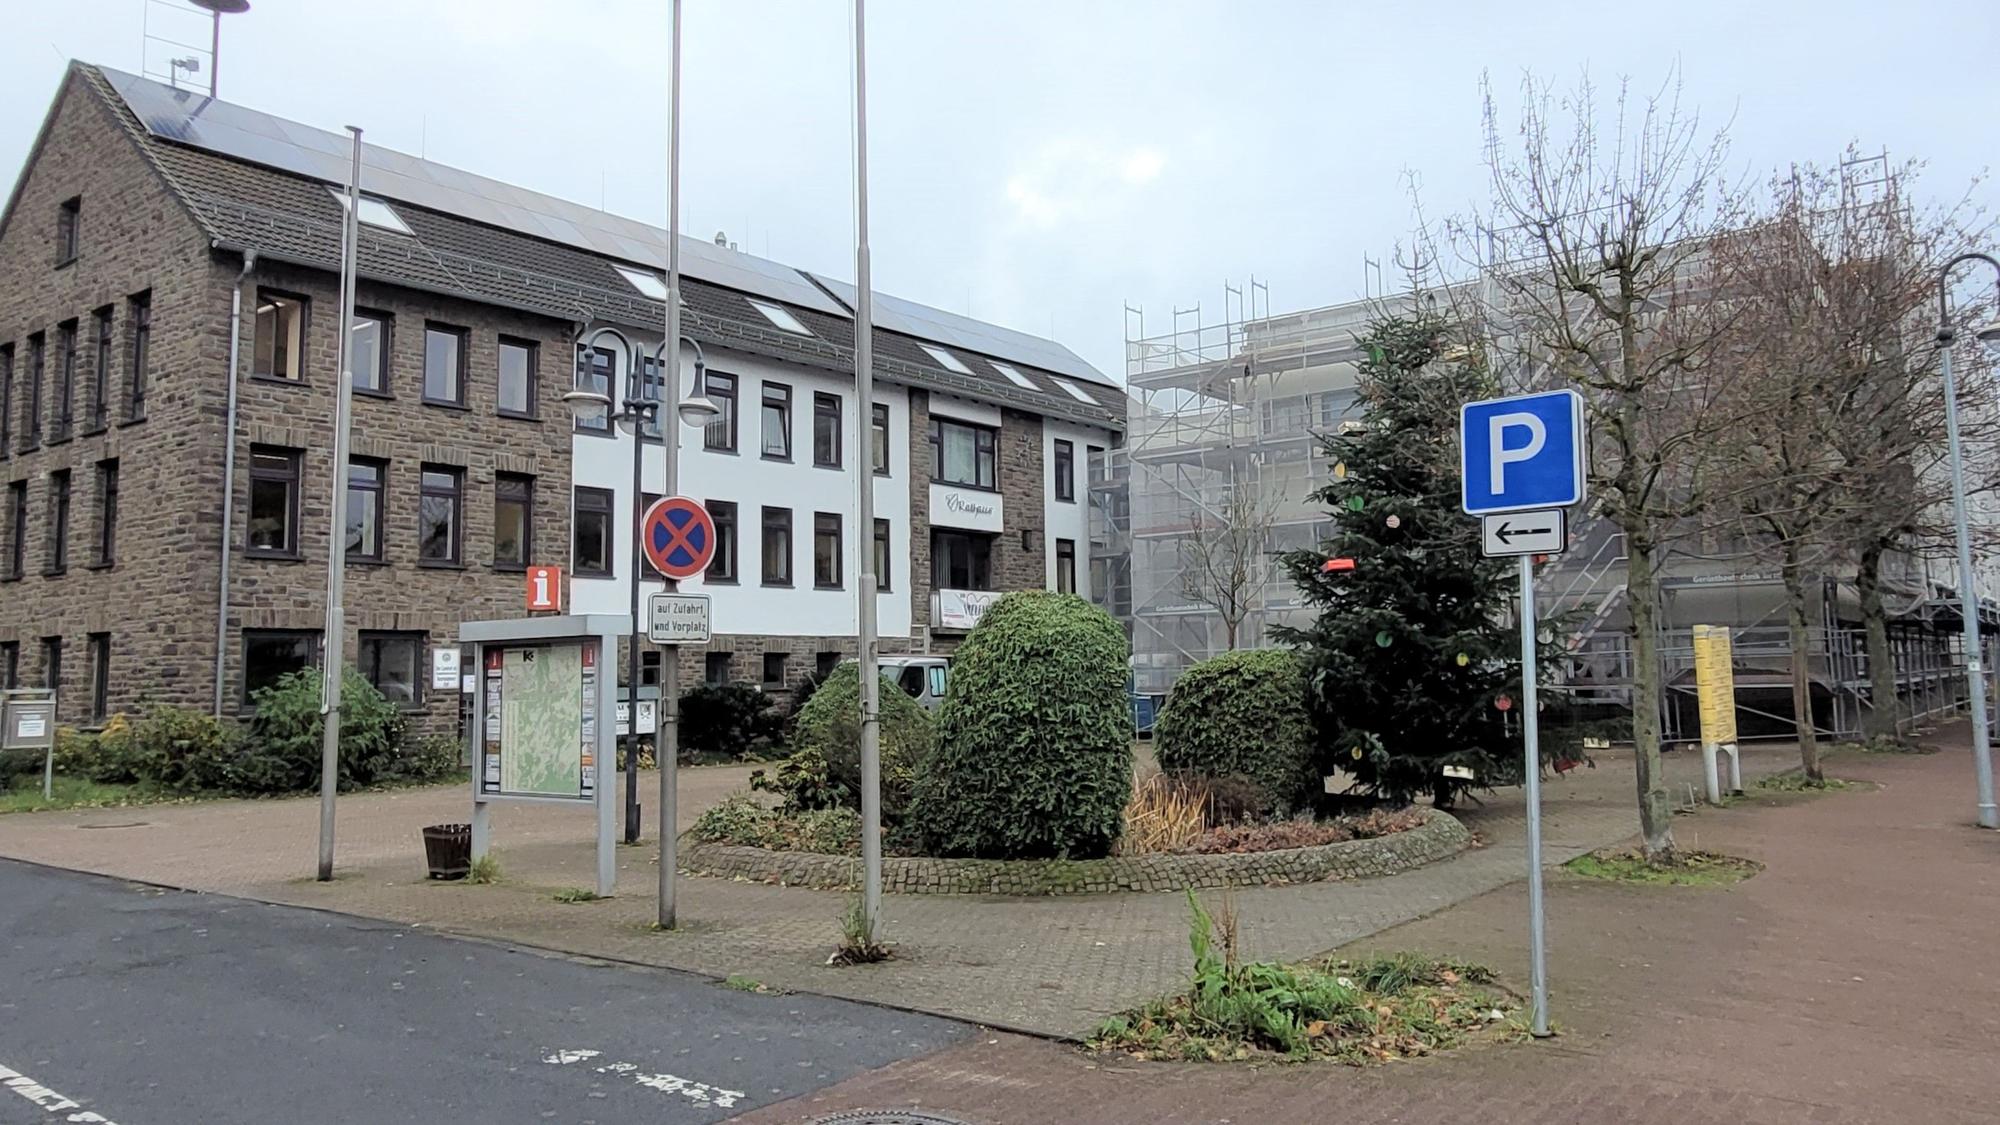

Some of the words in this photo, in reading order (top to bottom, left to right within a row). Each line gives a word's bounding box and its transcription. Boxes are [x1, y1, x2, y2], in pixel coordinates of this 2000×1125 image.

[1489, 412, 1547, 496] P
[657, 603, 671, 614] auf
[673, 602, 704, 615] Zufahrt
[654, 620, 670, 631] und
[672, 620, 707, 634] Vorplatz
